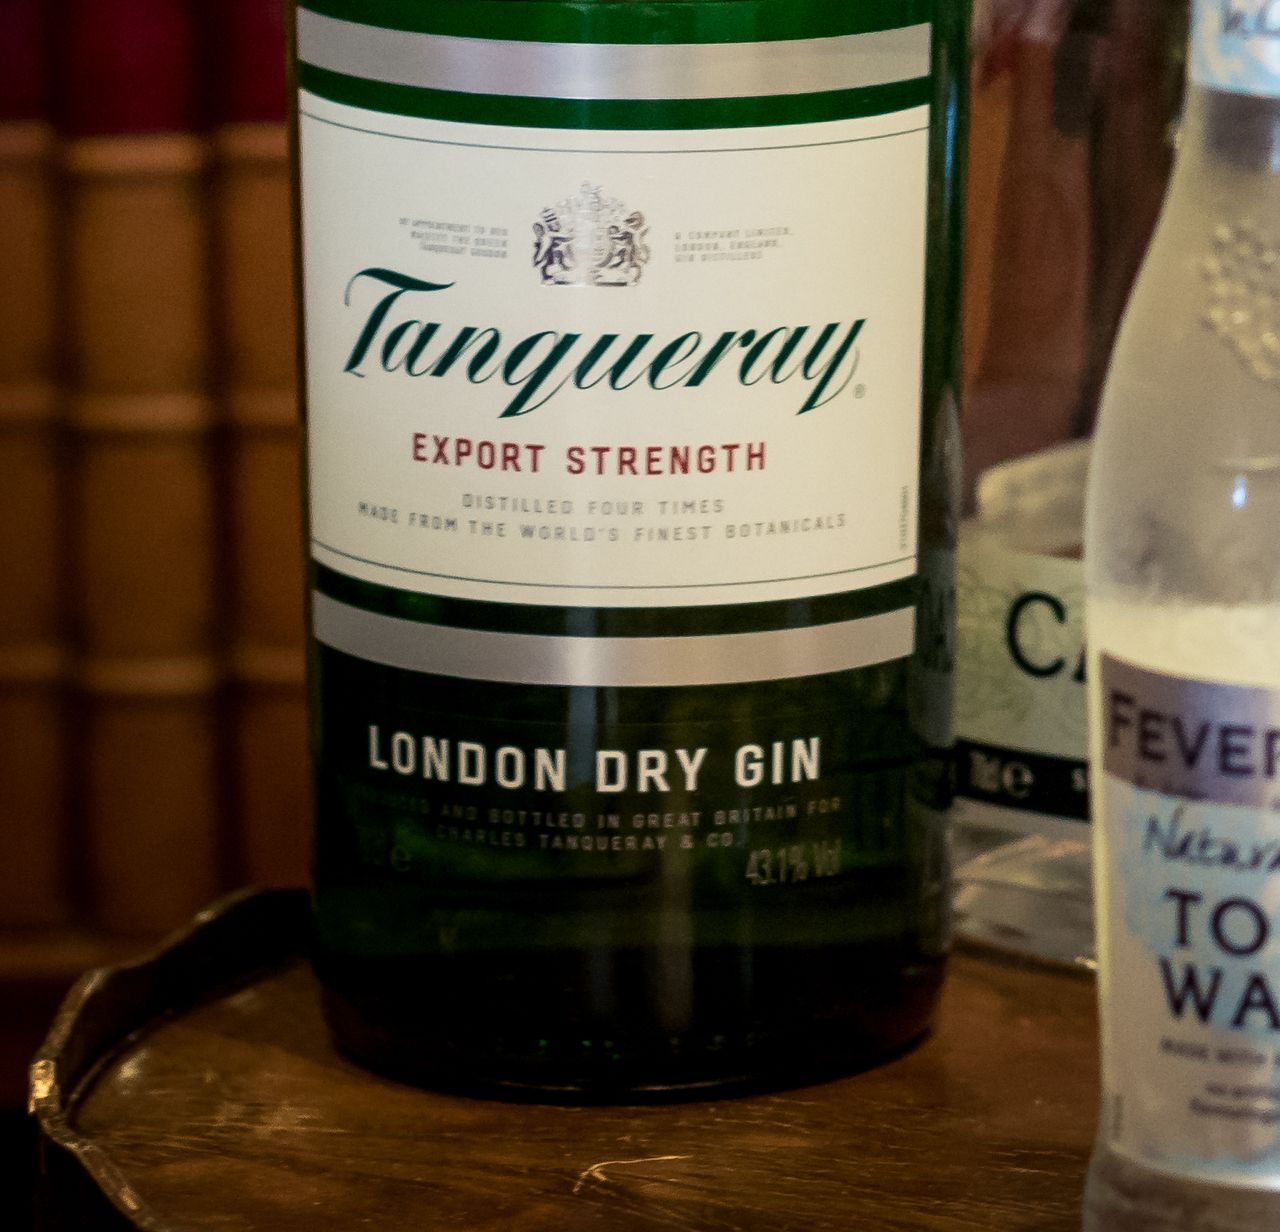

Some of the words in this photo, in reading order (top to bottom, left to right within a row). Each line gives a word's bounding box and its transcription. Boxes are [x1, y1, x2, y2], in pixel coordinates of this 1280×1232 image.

[343, 267, 868, 419] Tanqueray
[411, 432, 546, 474] EXPORT
[565, 441, 767, 477] STRENGTH
[357, 500, 399, 524] MADE
[407, 511, 459, 533] FROM
[468, 519, 507, 538] THE
[519, 523, 620, 542] WORLD'S
[633, 524, 714, 542] FINEST
[724, 512, 847, 540] BOTANICALS
[460, 492, 575, 515] DISTILLED
[587, 499, 644, 516] FOUR
[657, 498, 726, 516] TIMES
[368, 724, 567, 793] LONDON
[595, 747, 708, 793] DRY
[734, 736, 821, 788] GIN
[487, 808, 586, 830] BOTTLED
[632, 812, 701, 829] GREAT
[538, 832, 669, 852] TANQUERAY
